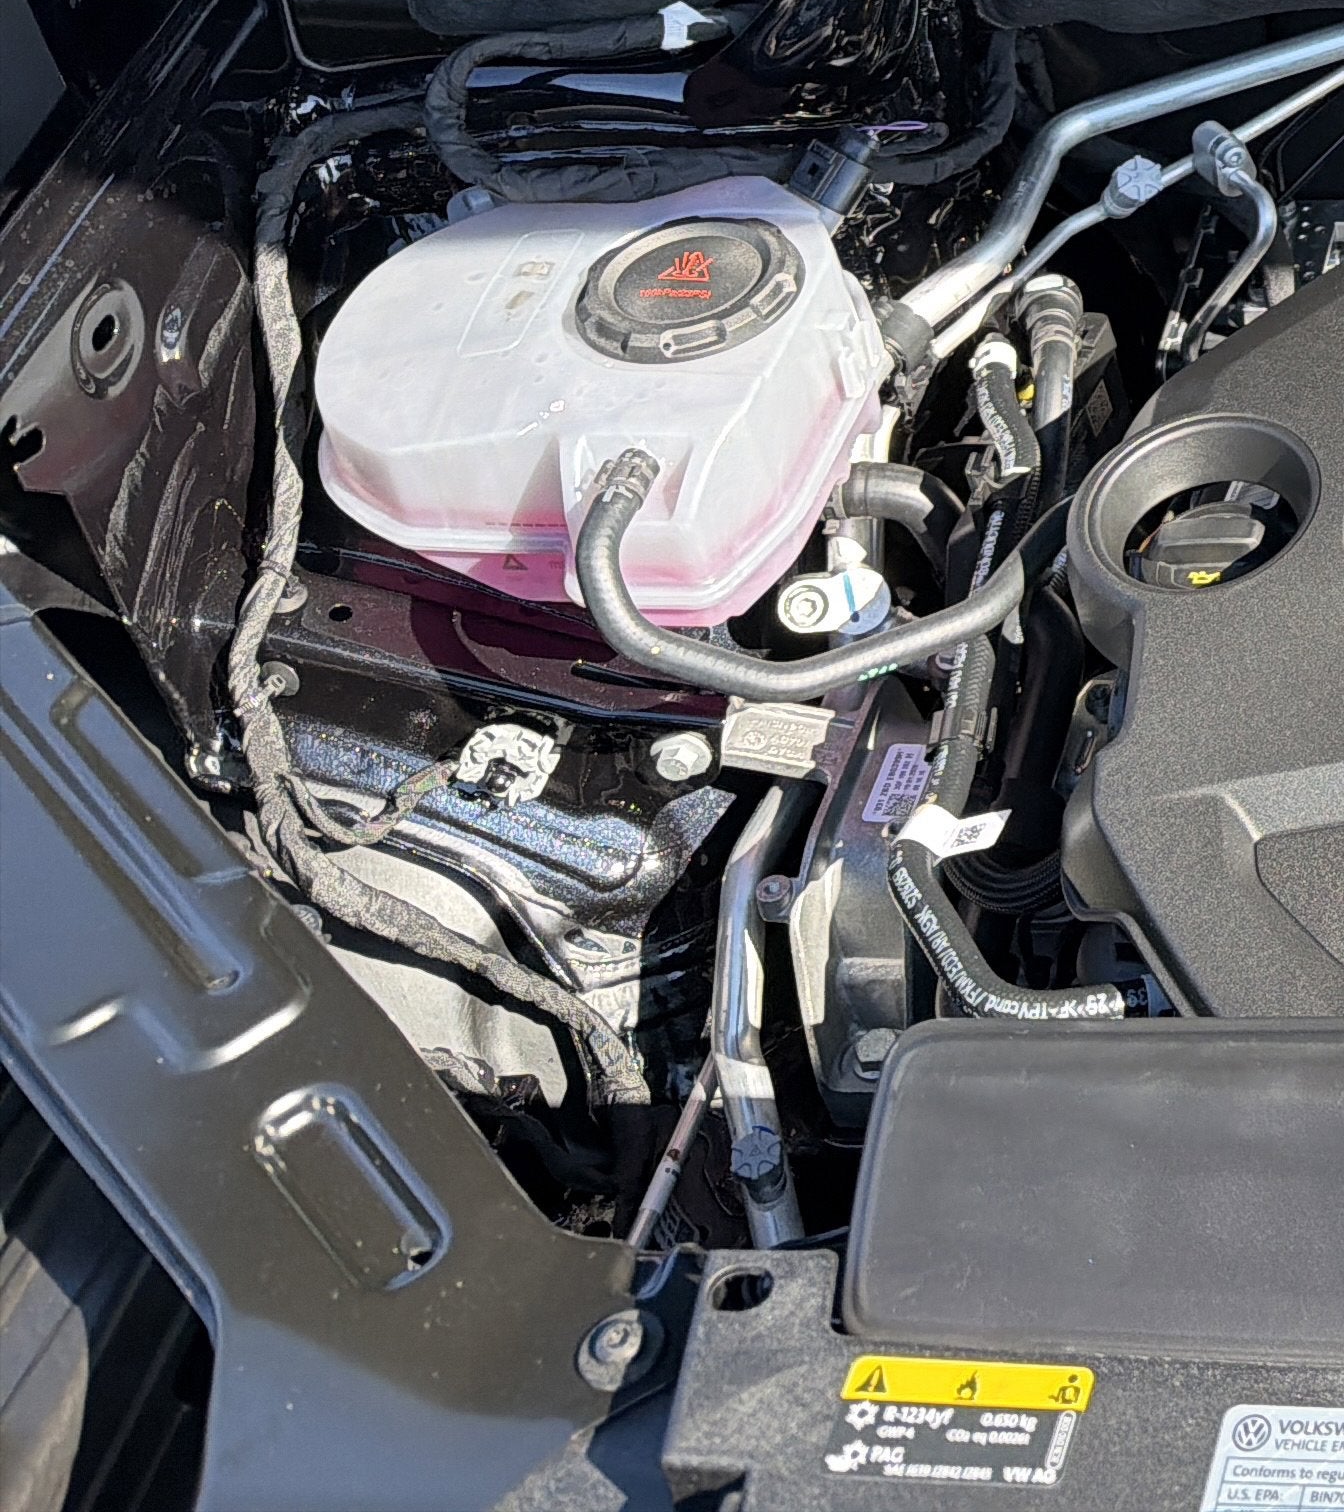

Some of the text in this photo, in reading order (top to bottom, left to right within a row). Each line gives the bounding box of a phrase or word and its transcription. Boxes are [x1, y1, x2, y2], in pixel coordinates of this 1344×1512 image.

[883, 1405, 954, 1429] R-1234yf
[1020, 1414, 1038, 1432] kg
[1275, 1438, 1327, 1452] VEHICLE
[869, 1446, 905, 1463] PAG
[1003, 1466, 1058, 1485] VW AG
[1233, 1464, 1296, 1478] Conforms
[1299, 1467, 1313, 1479] to
[1227, 1488, 1251, 1501] U.S.
